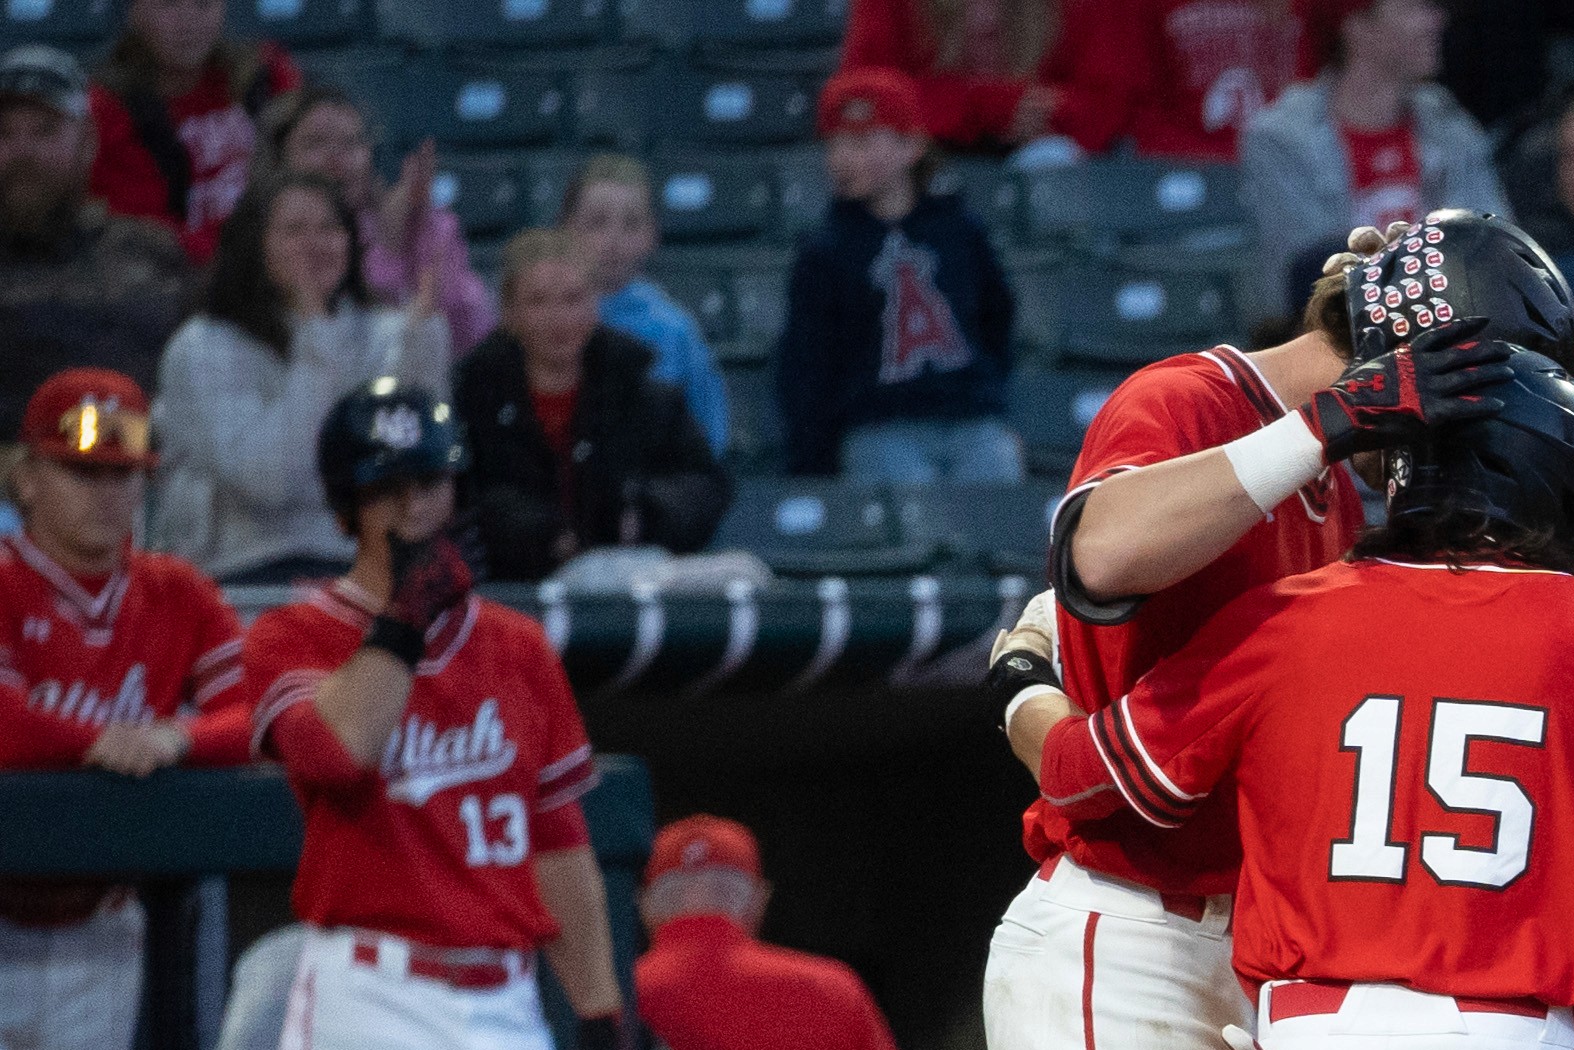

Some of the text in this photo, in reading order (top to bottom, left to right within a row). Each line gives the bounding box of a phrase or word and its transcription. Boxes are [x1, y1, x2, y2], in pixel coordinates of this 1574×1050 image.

[876, 236, 976, 384] A
[459, 793, 530, 868] 13
[1328, 693, 1549, 892] 15
